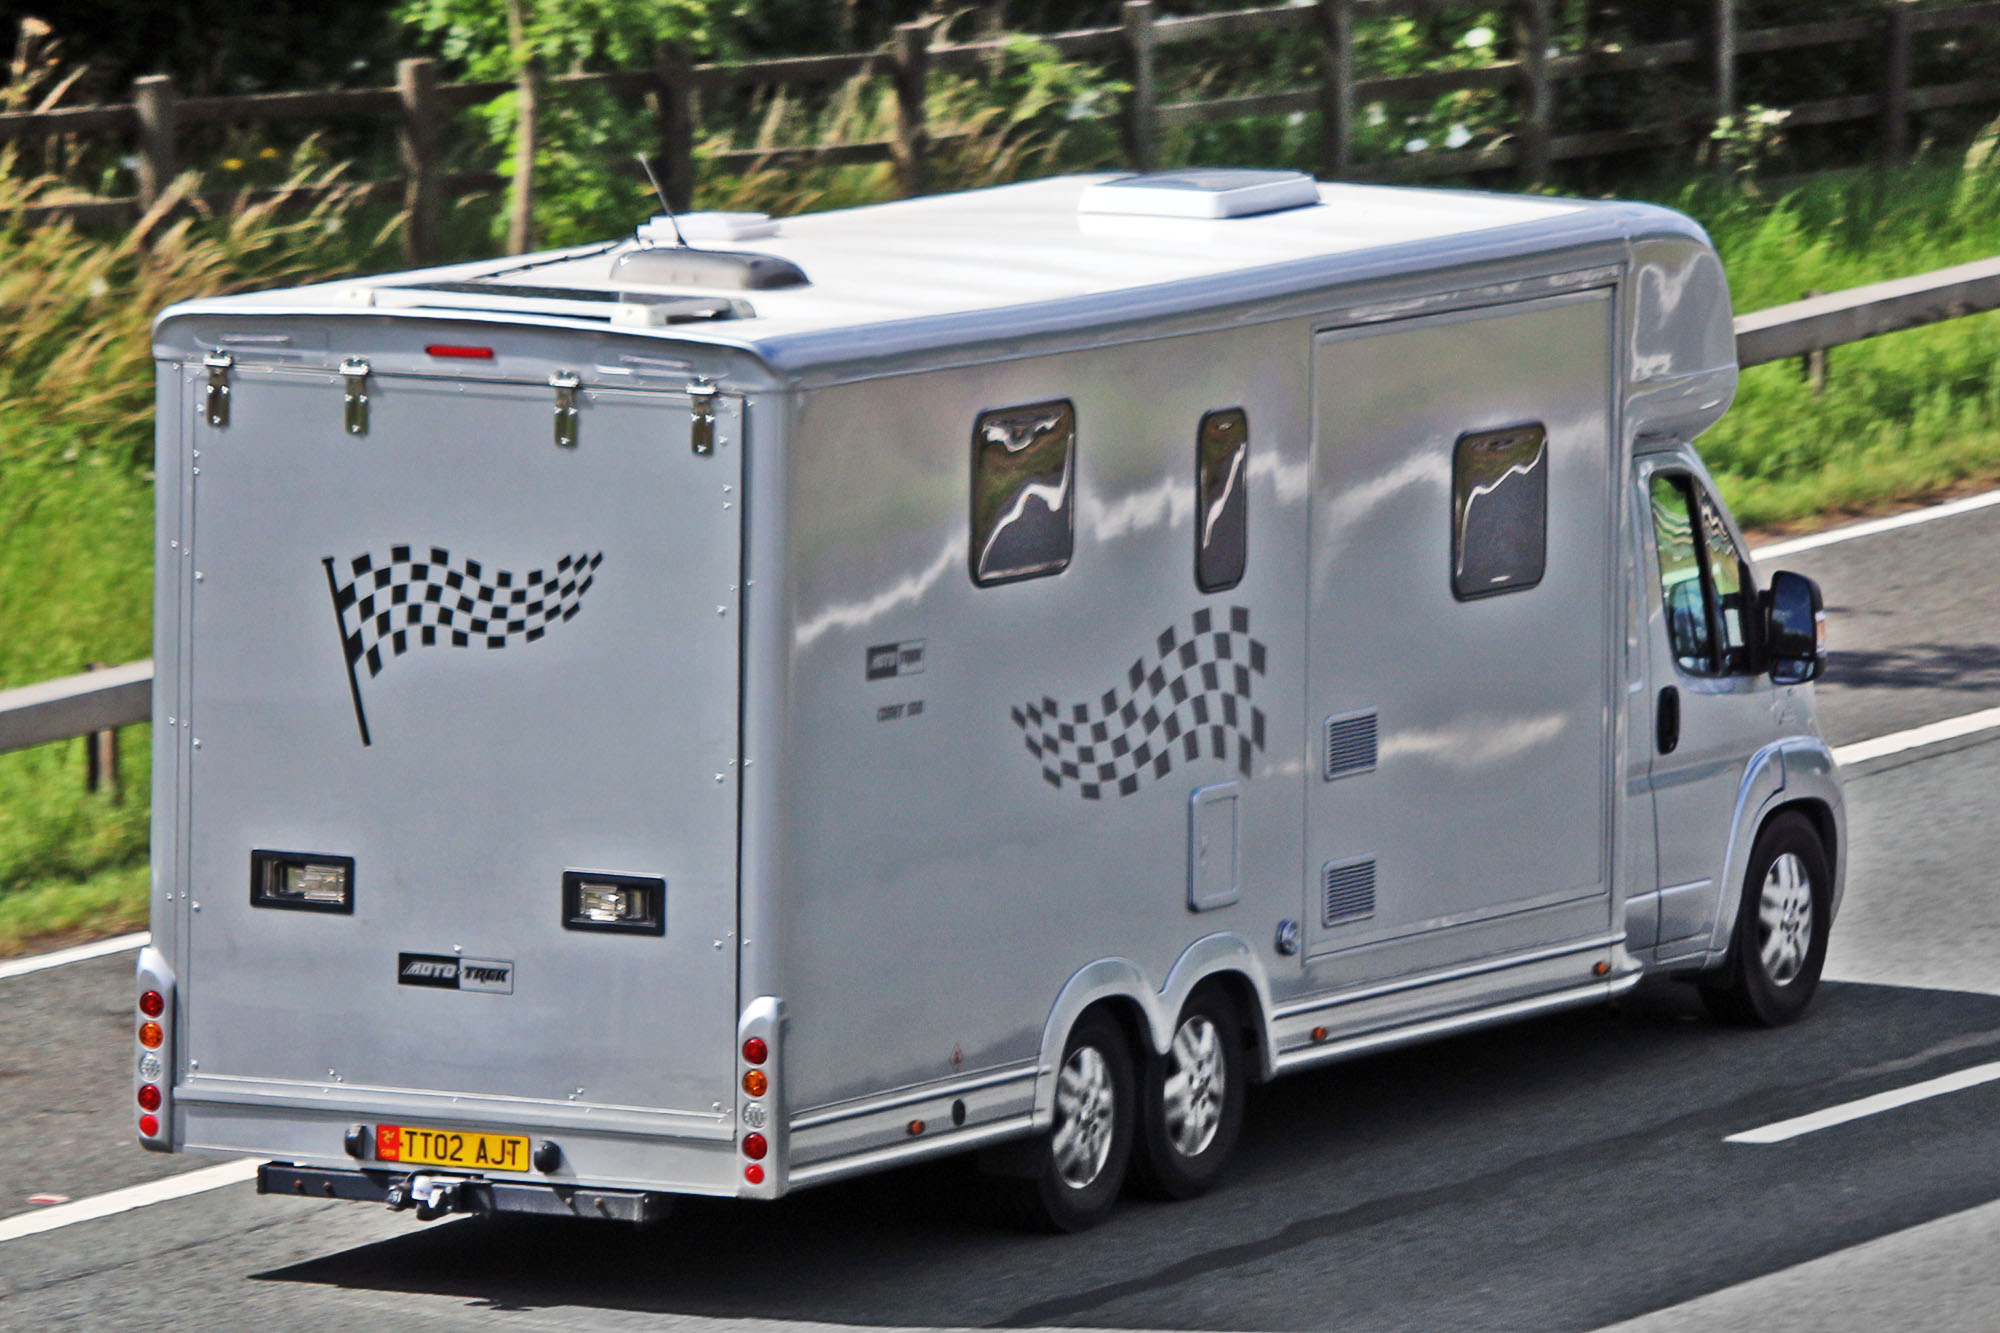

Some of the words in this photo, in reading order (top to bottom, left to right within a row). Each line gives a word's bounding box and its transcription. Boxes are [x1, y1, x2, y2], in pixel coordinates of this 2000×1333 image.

[402, 960, 458, 979] MOTO
[464, 965, 510, 983] TREK
[404, 1130, 464, 1162] TT02
[475, 1137, 522, 1166] AJT
